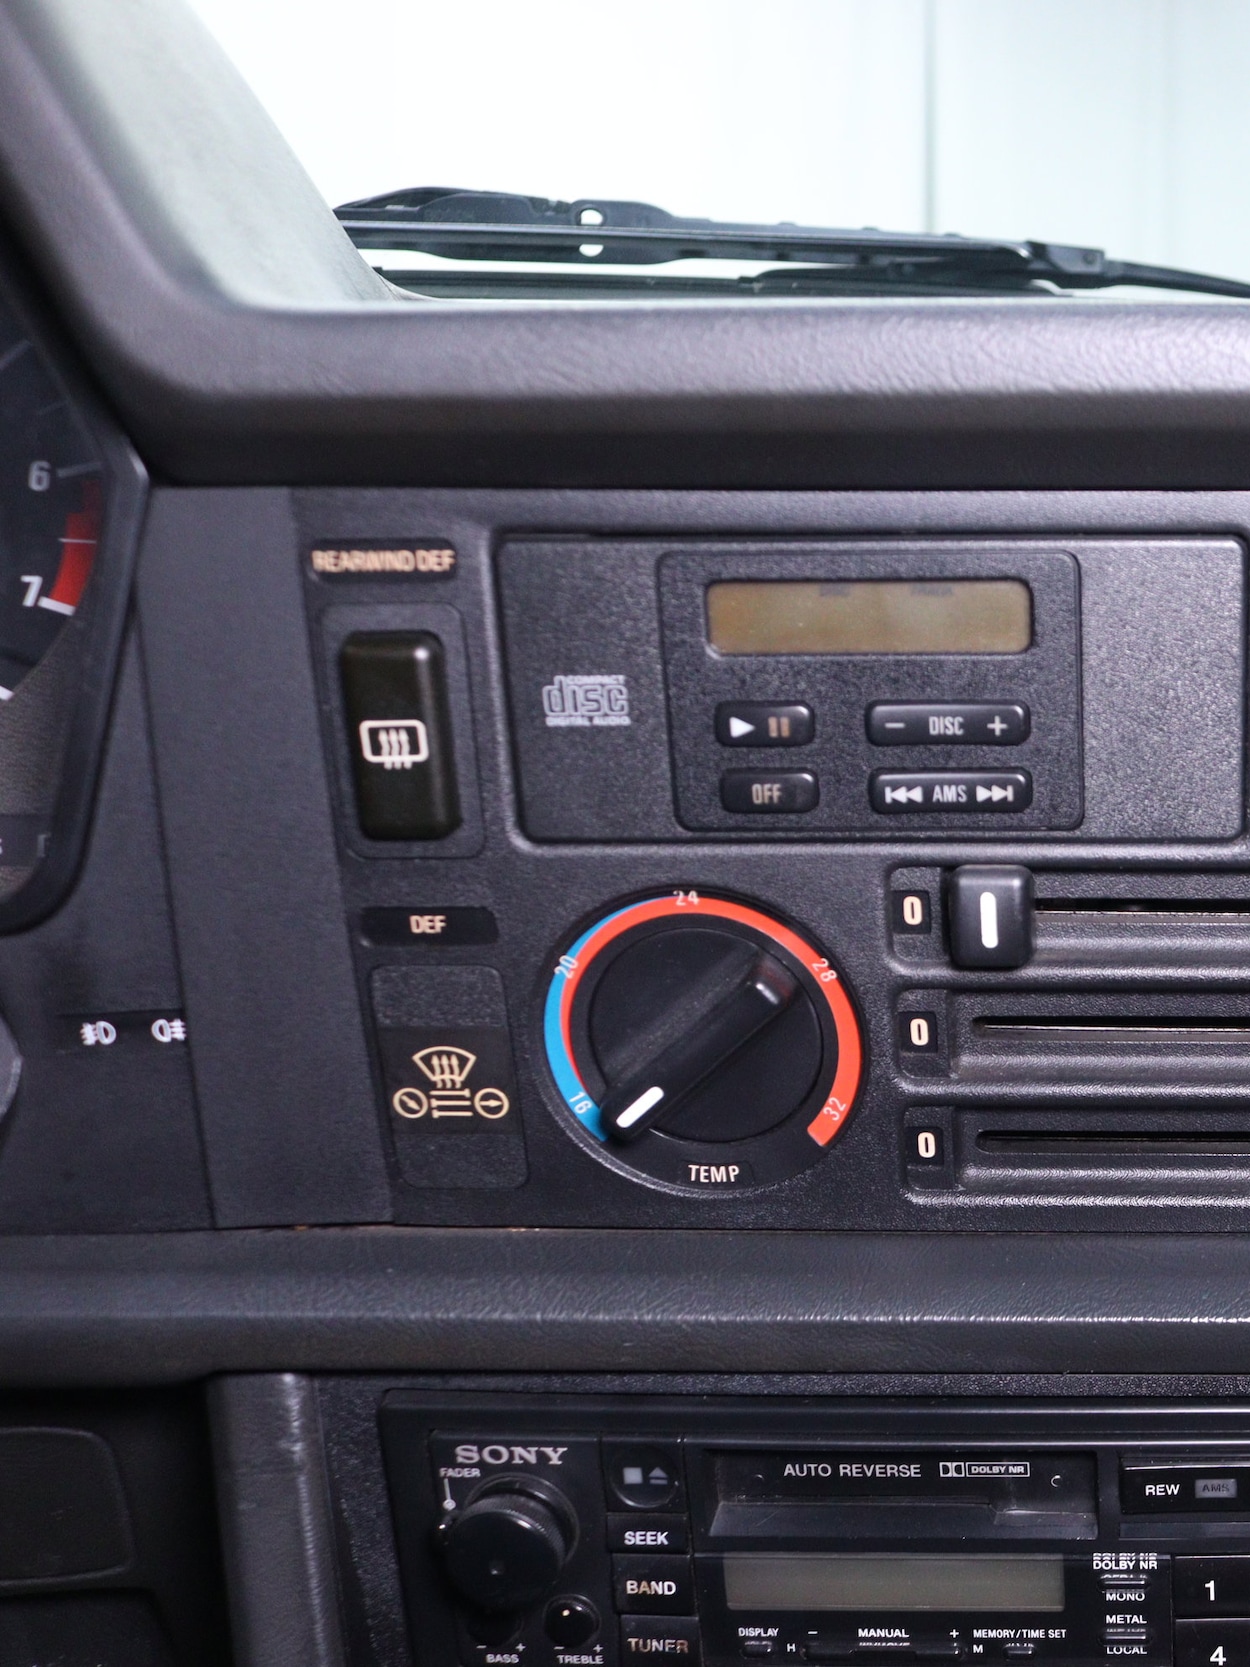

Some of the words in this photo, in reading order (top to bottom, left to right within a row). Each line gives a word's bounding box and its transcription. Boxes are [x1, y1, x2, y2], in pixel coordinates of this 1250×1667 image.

[28, 460, 51, 492] 6
[415, 550, 456, 572] DEF
[20, 575, 43, 607] 7
[928, 716, 964, 735] DISC
[751, 783, 782, 805] OFF
[932, 784, 967, 803] AMS
[672, 889, 700, 906] 24
[409, 915, 446, 934] DEF
[554, 954, 579, 979] 20
[811, 957, 837, 984] 28
[568, 1090, 592, 1116] 16
[822, 1096, 848, 1122] 32
[687, 1164, 740, 1183] TEMP
[455, 1444, 568, 1465] SONY
[439, 1467, 481, 1478] FADER
[783, 1463, 832, 1477] AUTO
[839, 1463, 922, 1478] REVERSE
[971, 1465, 1007, 1475] DOLBY
[1007, 1465, 1025, 1475] NR
[1145, 1483, 1181, 1496] REW
[1202, 1483, 1230, 1493] AMS
[624, 1530, 669, 1546] SEEK
[1092, 1560, 1136, 1571] DOLBY
[1139, 1560, 1158, 1571] NR
[626, 1580, 677, 1596] BAND
[1204, 1580, 1215, 1601] 1
[1105, 1592, 1146, 1602] MONO
[1105, 1614, 1148, 1624] METAL
[738, 1627, 780, 1637] DISPLAY
[857, 1628, 910, 1638] MANUAL
[973, 1628, 1045, 1639] MEMORY/TIME
[1047, 1628, 1067, 1639] SET
[627, 1637, 689, 1654] TUNER
[786, 1643, 796, 1653] H
[972, 1644, 984, 1654] M
[1106, 1646, 1148, 1655] LOCAL
[486, 1653, 520, 1664] BASS
[556, 1654, 604, 1665] TREBLE
[1209, 1645, 1227, 1666] 4
